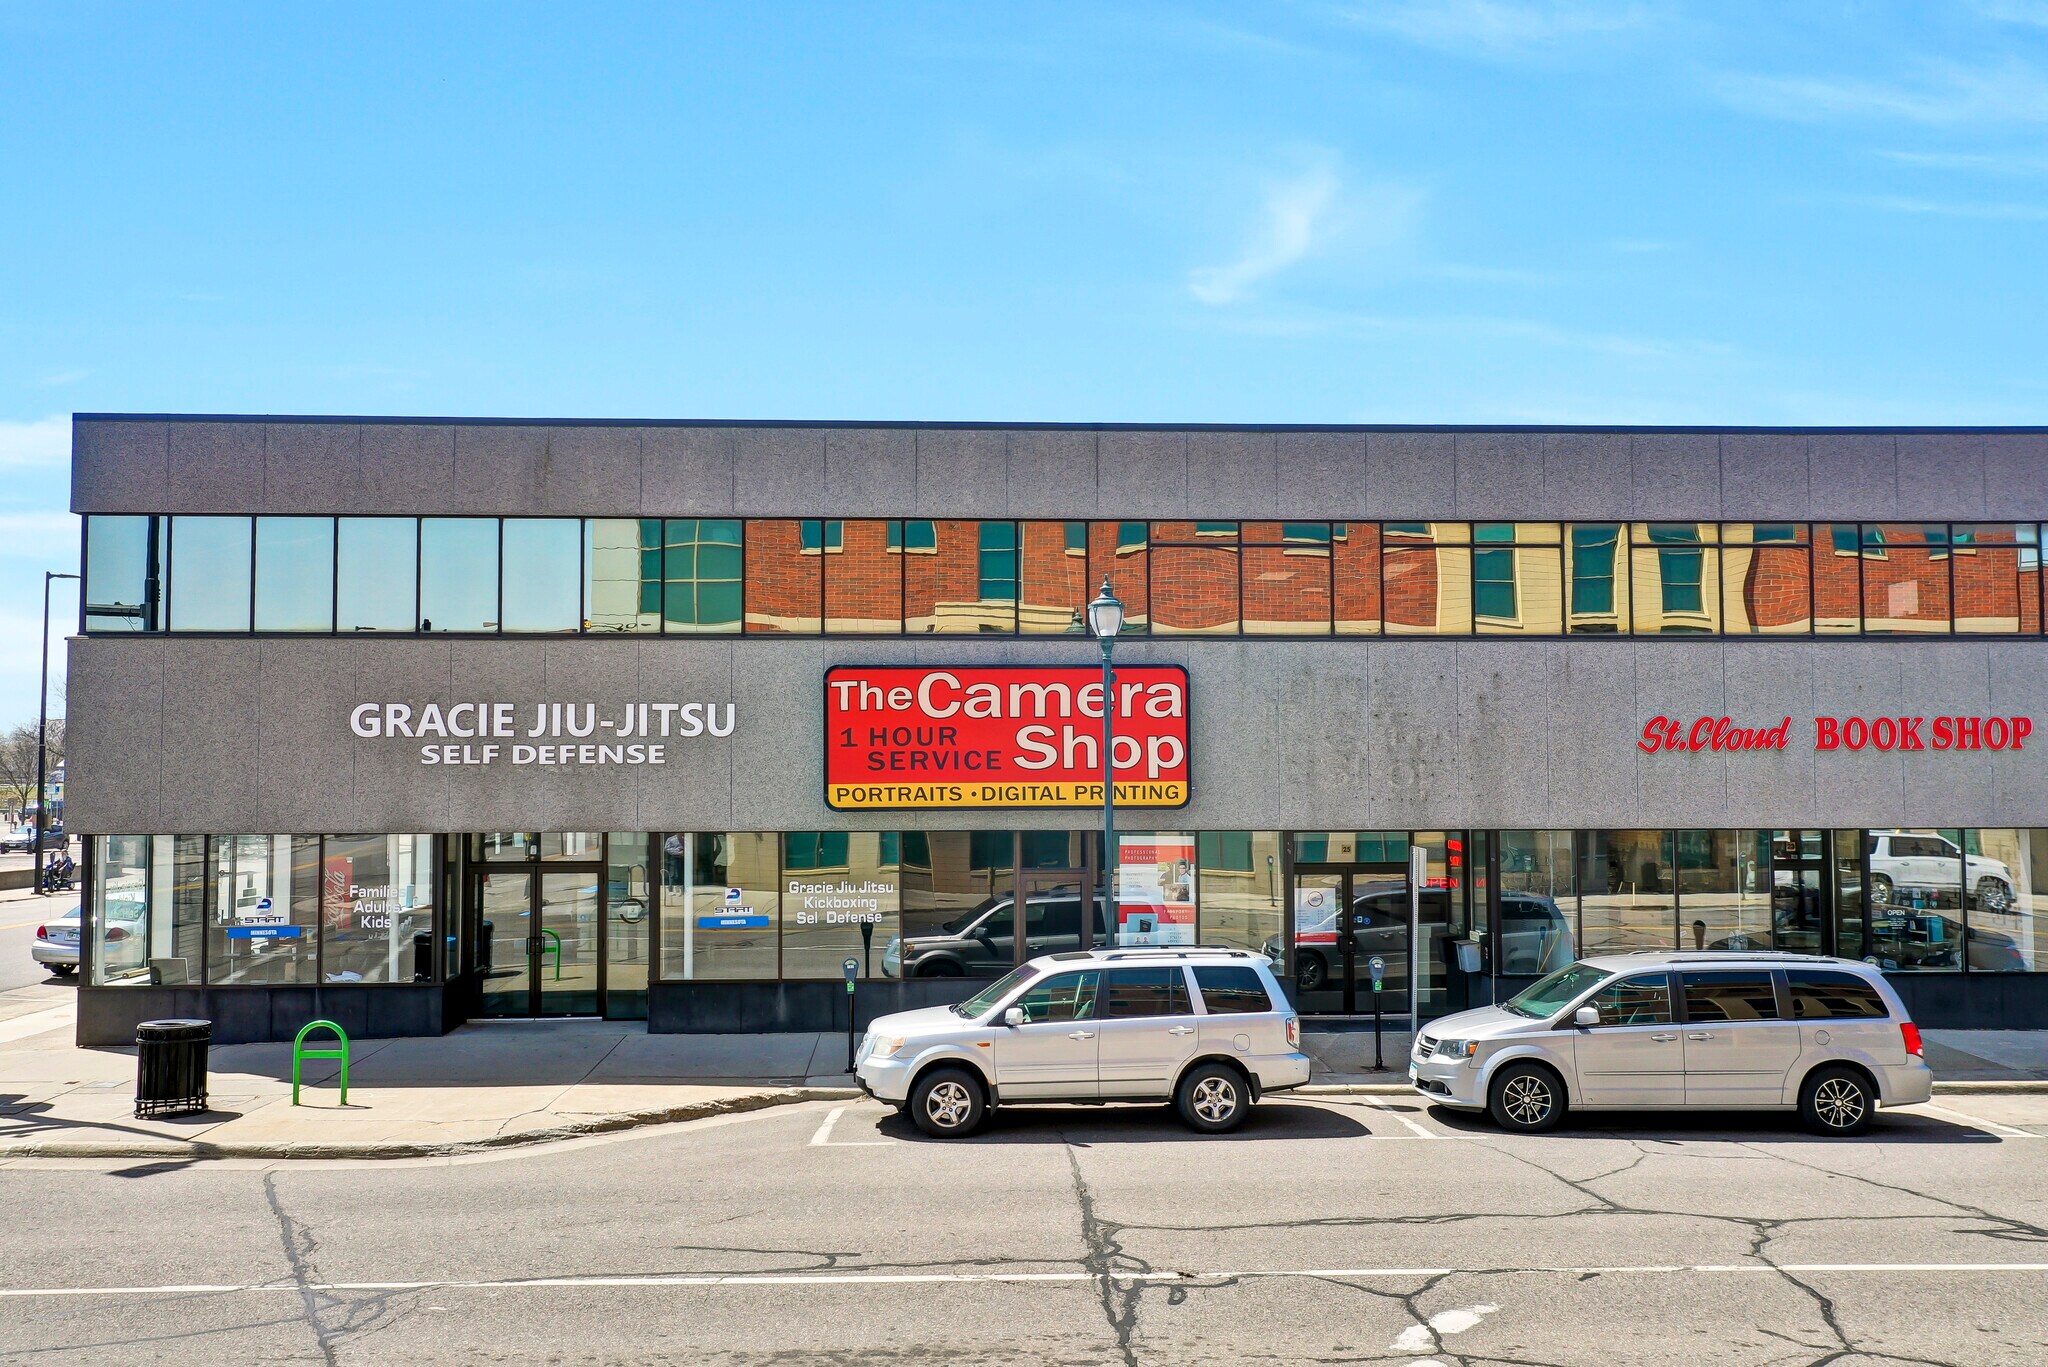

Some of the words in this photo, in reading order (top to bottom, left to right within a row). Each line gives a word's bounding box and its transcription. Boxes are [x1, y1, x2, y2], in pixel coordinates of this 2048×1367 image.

[830, 680, 913, 712] The
[917, 671, 1185, 719] Camera
[349, 702, 515, 738] GRACIE
[527, 702, 737, 738] JIU-JITSU
[840, 728, 858, 748] 1
[868, 726, 958, 747] HOUR
[1813, 716, 1925, 751] BOOK
[1930, 716, 2034, 751] SHOP
[420, 744, 500, 765] SELF
[512, 744, 667, 765] DEFENSE
[1013, 723, 1185, 779] Shop
[867, 750, 1002, 772] SERVICE
[836, 786, 963, 802] PORTRAITS
[981, 786, 1068, 801] DIGITAL
[1074, 785, 1180, 801] PRNTING
[1342, 845, 1351, 853] 25
[349, 884, 405, 898] Families
[788, 881, 834, 894] Gracie
[836, 881, 856, 894] Jiu
[859, 881, 894, 894] Jitsu
[804, 895, 877, 911] Kickboxing
[361, 915, 391, 929] Kids
[826, 911, 882, 924] Defense
